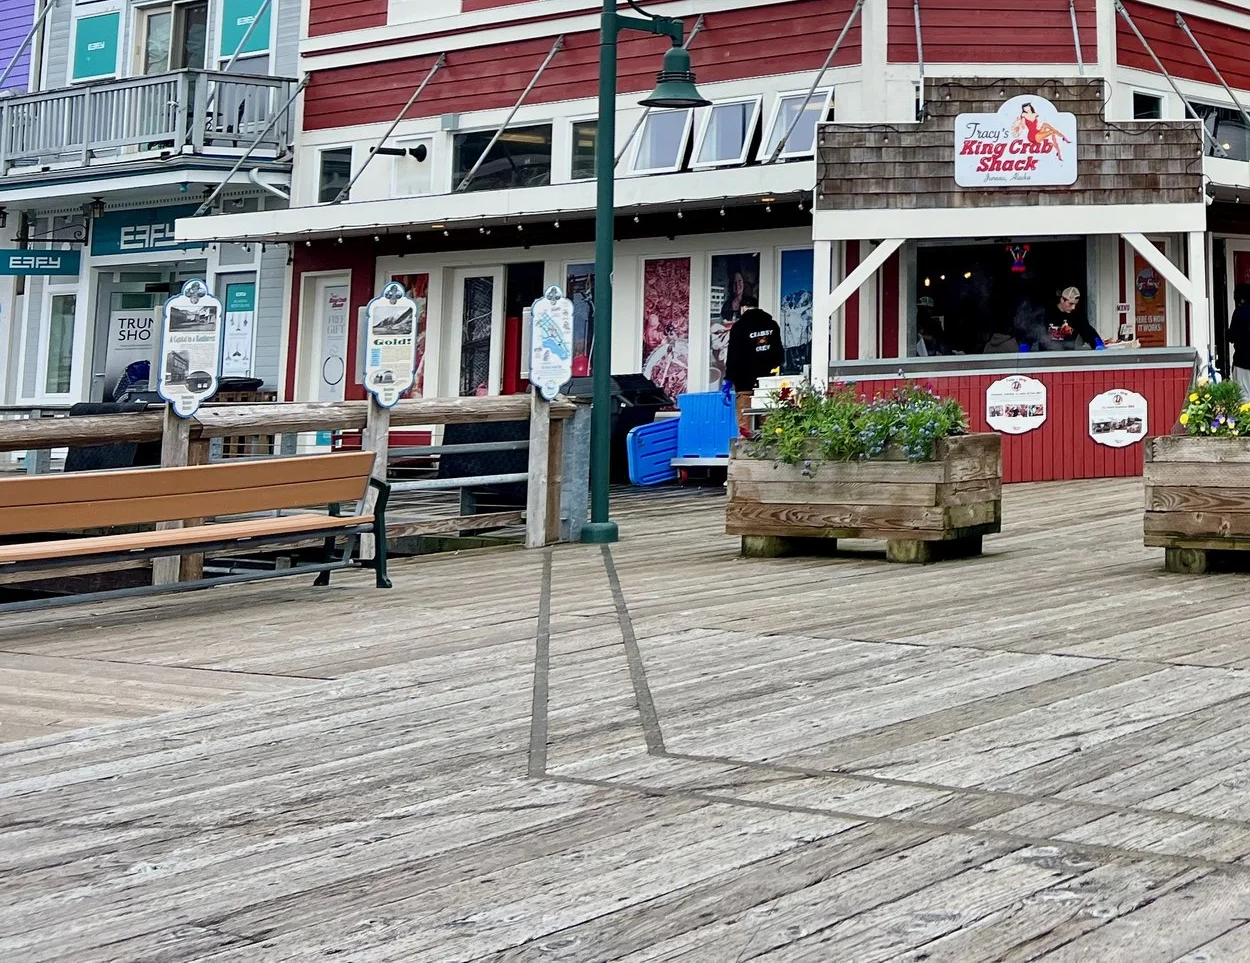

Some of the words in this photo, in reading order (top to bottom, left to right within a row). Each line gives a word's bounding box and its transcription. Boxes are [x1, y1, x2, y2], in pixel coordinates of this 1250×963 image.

[965, 122, 1009, 142] Tracy's
[960, 140, 1007, 157] King
[1009, 139, 1053, 154] Crab
[976, 155, 1038, 172] Shack
[9, 256, 60, 268] EFFY
[118, 318, 154, 329] TRUN
[118, 329, 151, 341] SHO
